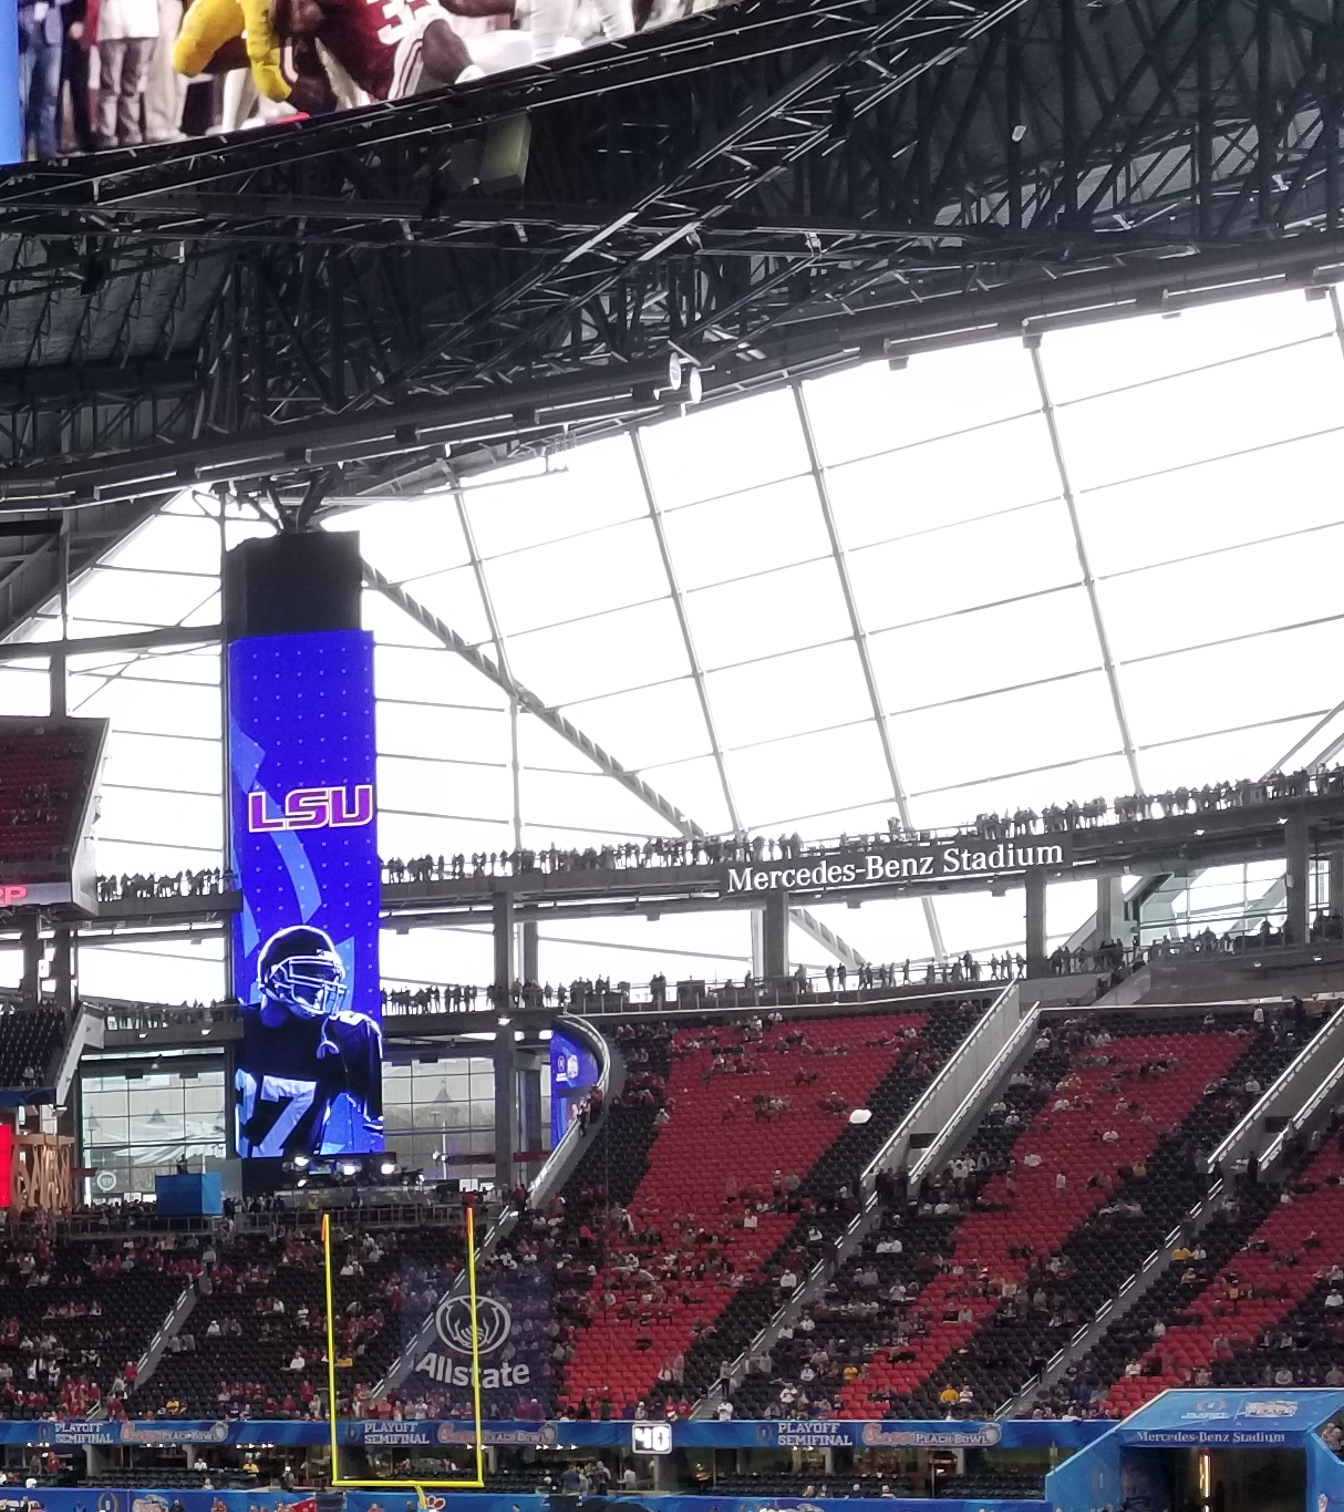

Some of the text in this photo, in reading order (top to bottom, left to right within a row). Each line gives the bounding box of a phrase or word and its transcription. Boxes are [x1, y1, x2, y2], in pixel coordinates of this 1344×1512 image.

[248, 784, 373, 832] LSU
[727, 843, 1064, 893] Mercedes-Benz Stadium
[55, 1423, 103, 1433] PLAYOFF
[364, 1423, 418, 1433] PLAYOFF
[778, 1423, 840, 1434] PLAYOFF
[55, 1433, 114, 1444] SEMIFINAL
[364, 1434, 430, 1445] SEMIFINAL
[634, 1426, 670, 1451] 40
[778, 1434, 853, 1446] SEMIFINAL
[915, 1433, 953, 1444] PEACH
[954, 1434, 988, 1445] BOWL
[1136, 1431, 1286, 1443] Mercedes-Benz Stadium
